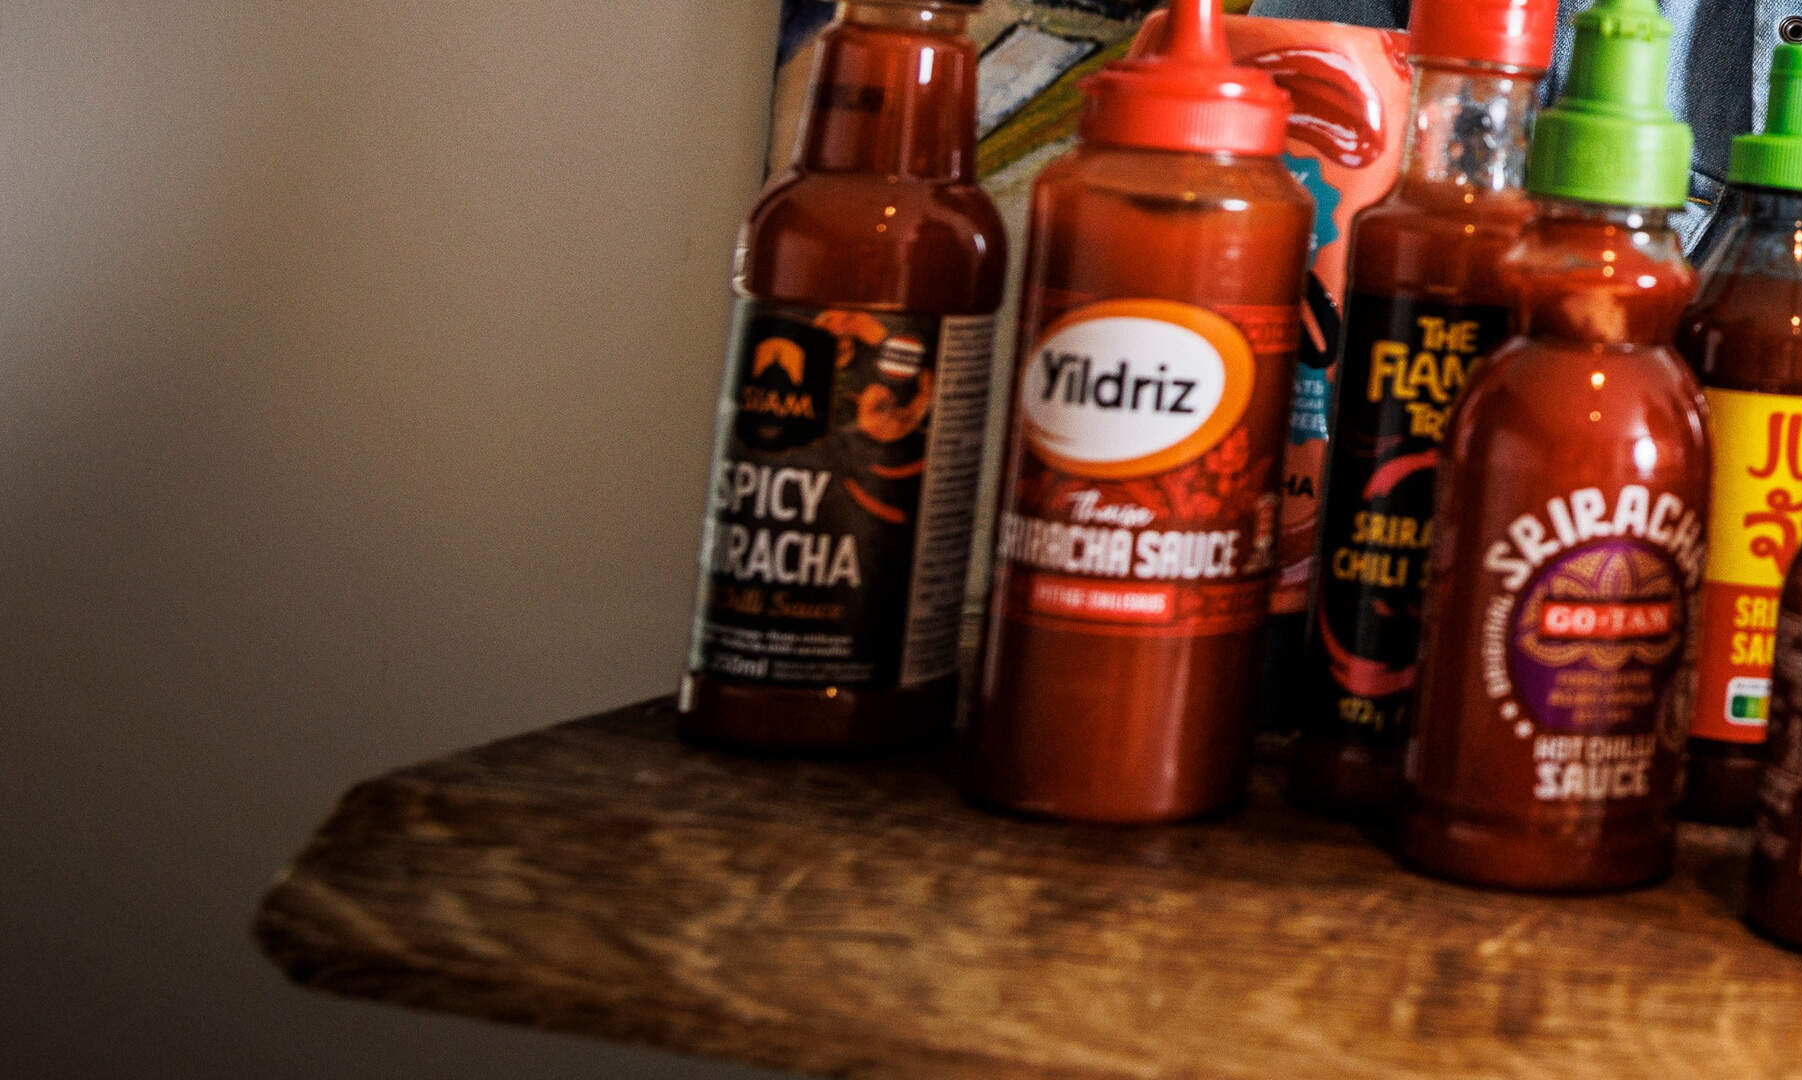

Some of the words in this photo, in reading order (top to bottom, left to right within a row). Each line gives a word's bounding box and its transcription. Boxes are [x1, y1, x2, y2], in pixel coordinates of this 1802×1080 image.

[1418, 316, 1479, 352] THE
[1041, 350, 1198, 414] Yildriz
[1367, 340, 1485, 403] FLAM
[717, 459, 832, 524] SPICY
[712, 522, 862, 588] RACHA
[1134, 529, 1240, 579] SAUCE
[1483, 484, 1704, 591] SRIRACHA
[1331, 547, 1410, 588] CHILI
[1533, 735, 1583, 760] HOT
[1533, 760, 1650, 800] SAUCE
